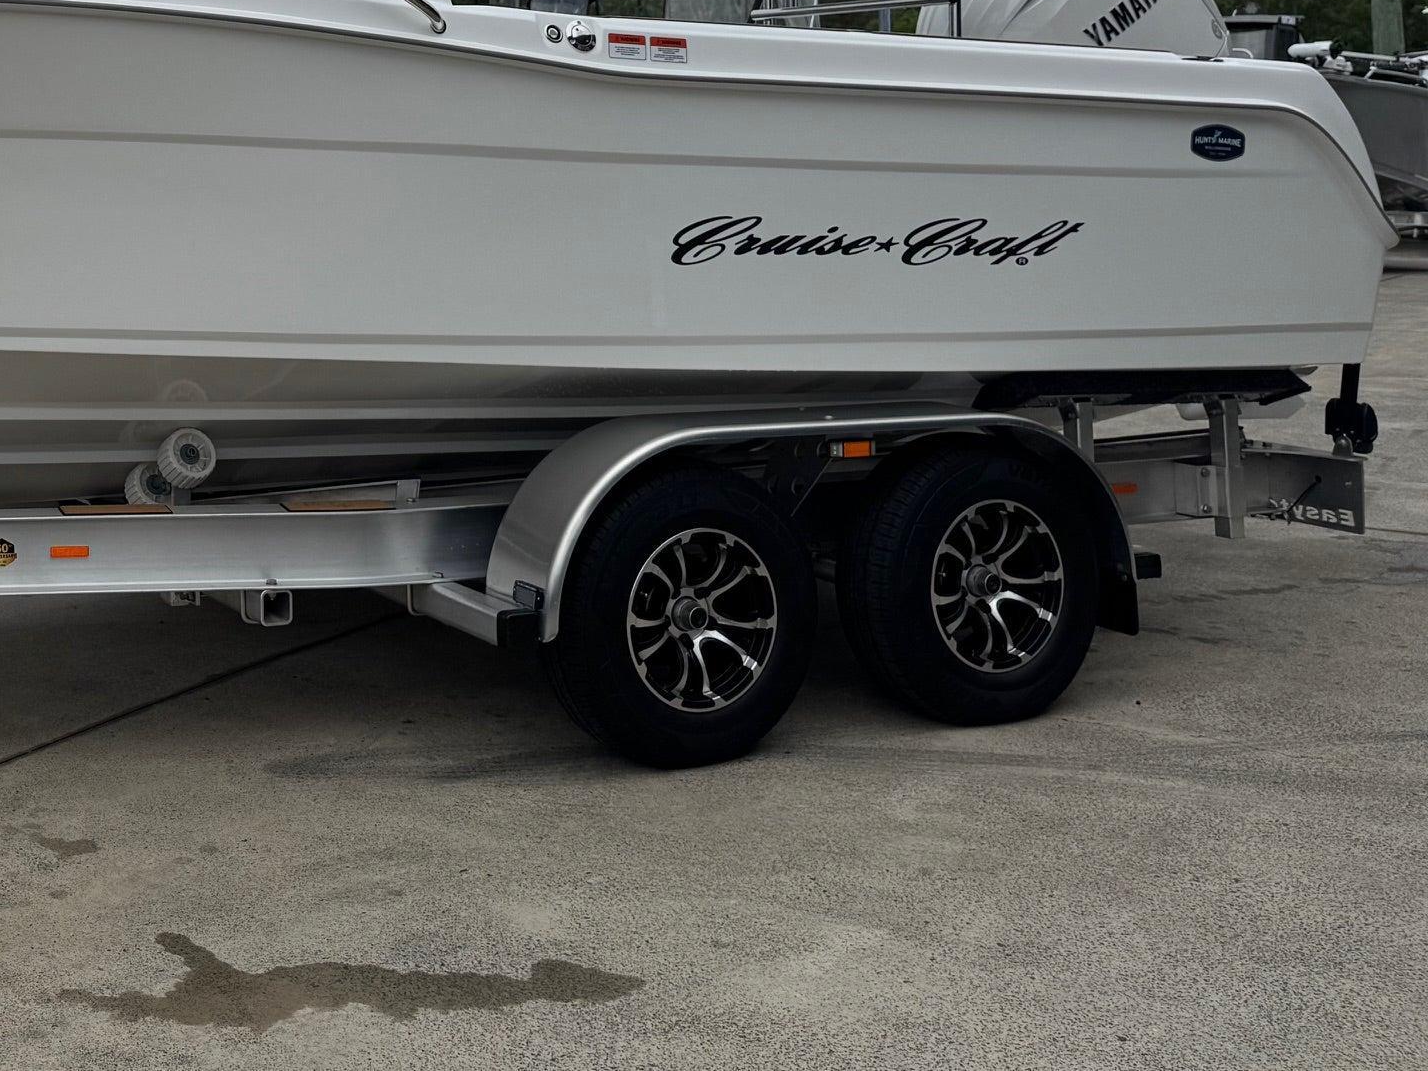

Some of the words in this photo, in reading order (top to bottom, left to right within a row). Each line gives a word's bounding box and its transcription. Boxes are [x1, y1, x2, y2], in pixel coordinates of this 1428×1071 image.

[1218, 137, 1242, 147] MARINE
[671, 215, 877, 266] Cruise
[901, 217, 1085, 266] Craft
